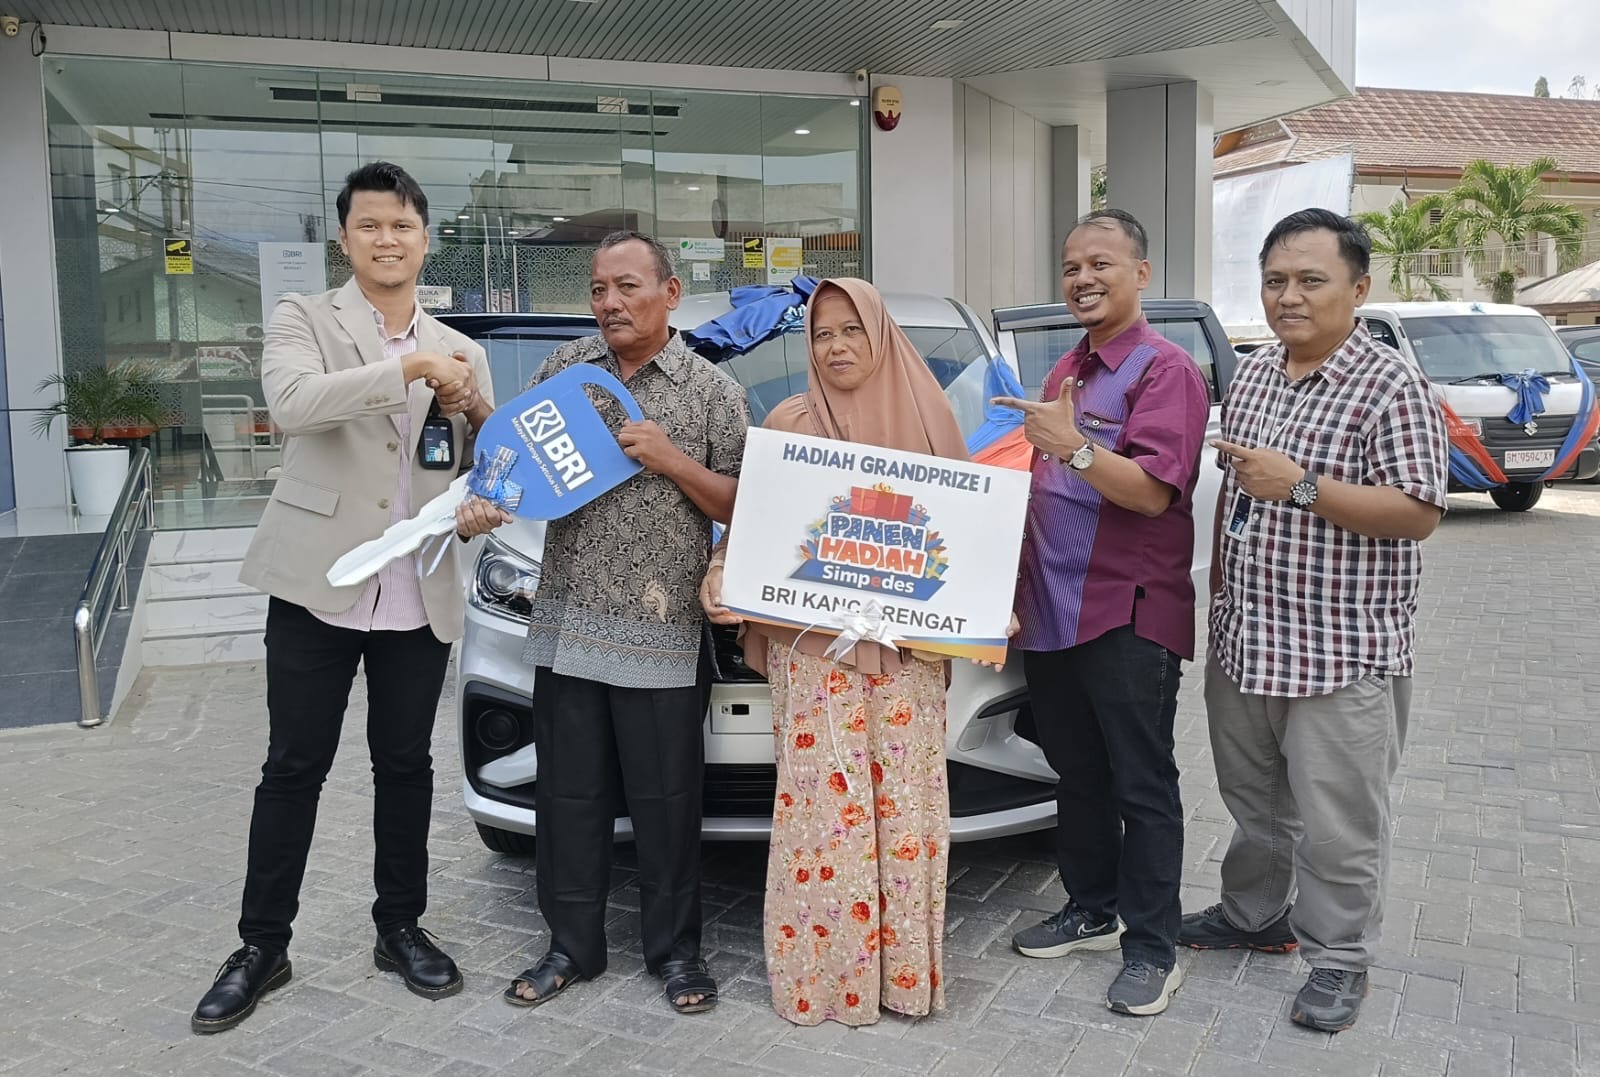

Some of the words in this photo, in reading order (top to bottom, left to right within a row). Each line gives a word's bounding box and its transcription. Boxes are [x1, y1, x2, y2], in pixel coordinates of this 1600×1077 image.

[526, 441, 543, 465] Dengan
[542, 432, 595, 491] BRI
[783, 442, 856, 471] HADIAH
[860, 455, 980, 492] GRANDPRIZE
[829, 514, 925, 551] PANEN
[819, 536, 926, 577] HADIAH
[822, 564, 915, 594] Simpedes
[761, 585, 796, 606] BRI
[802, 591, 867, 615] KANC
[881, 605, 967, 634] RENGAT
